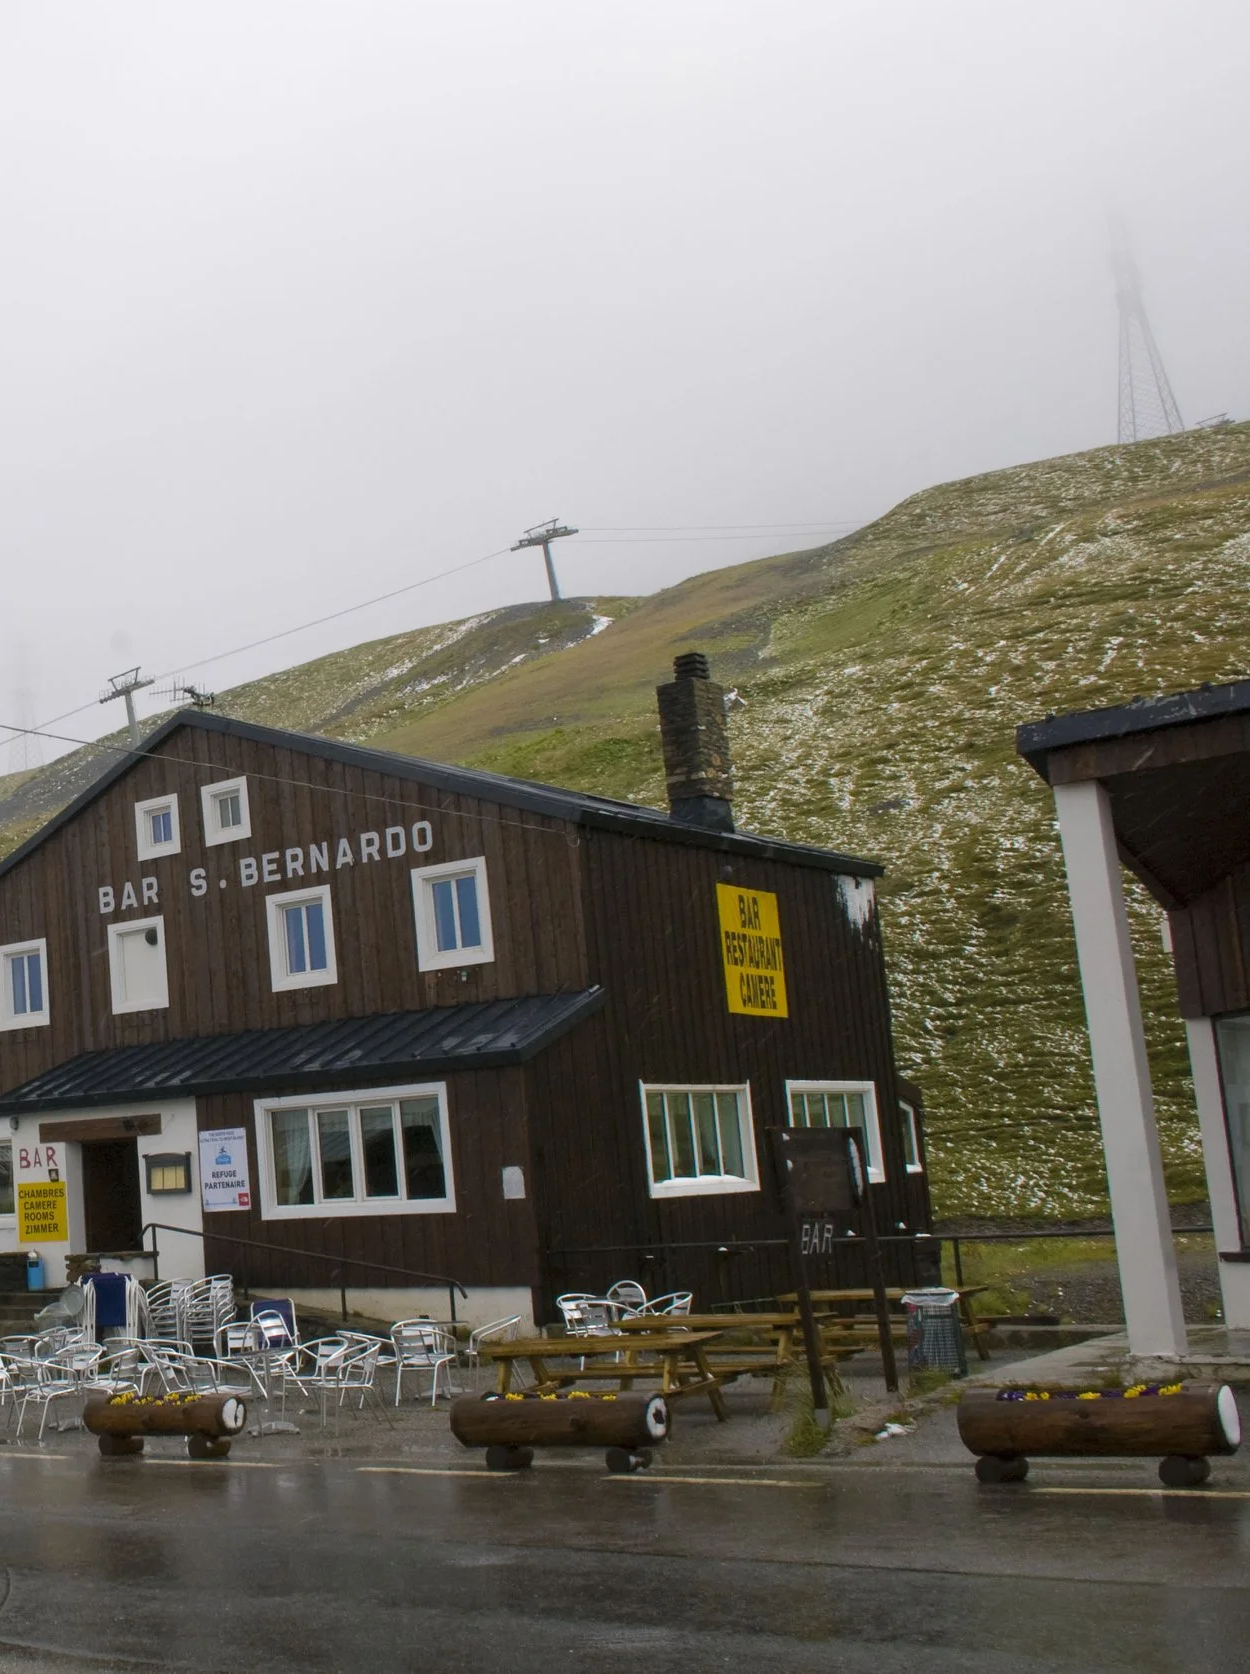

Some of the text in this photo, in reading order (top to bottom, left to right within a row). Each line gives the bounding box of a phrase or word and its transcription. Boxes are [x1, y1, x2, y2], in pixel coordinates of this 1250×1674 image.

[98, 876, 160, 914] BAR
[737, 894, 762, 931] BAR
[724, 930, 783, 972] RESTAURANT
[739, 972, 778, 1010] CAMERE
[19, 1146, 58, 1169] BAR
[211, 1169, 237, 1179] REFUGE
[18, 1188, 65, 1199] CHAMBRES
[204, 1180, 246, 1190] PARTENAIRE
[23, 1200, 57, 1210] CAMERE
[24, 1211, 55, 1222] ROOMS
[25, 1223, 60, 1235] ZIMMER
[801, 1221, 834, 1255] BAR
